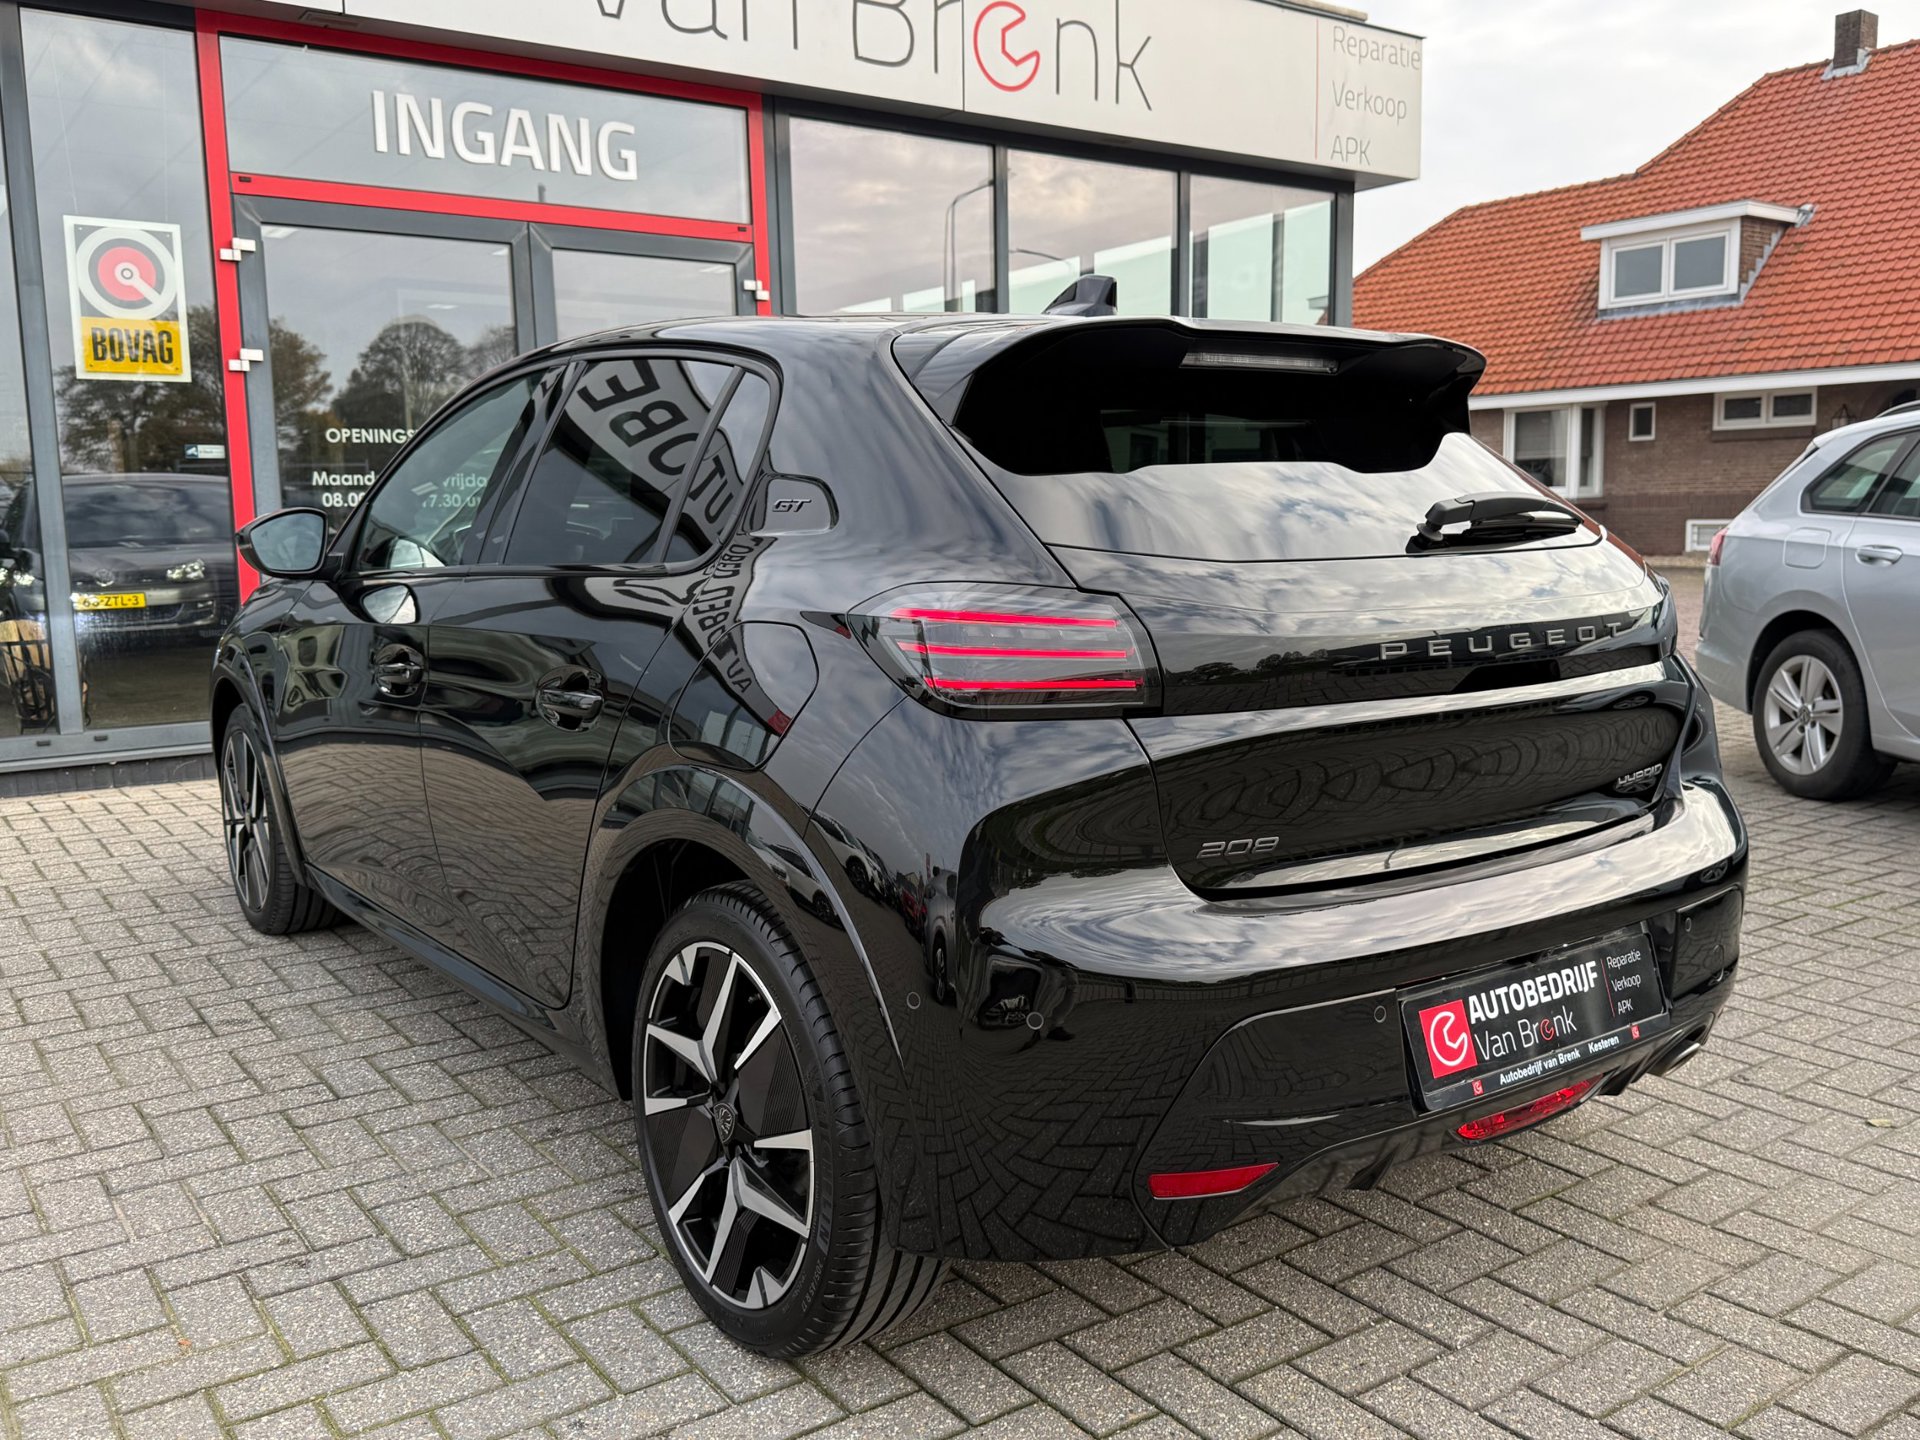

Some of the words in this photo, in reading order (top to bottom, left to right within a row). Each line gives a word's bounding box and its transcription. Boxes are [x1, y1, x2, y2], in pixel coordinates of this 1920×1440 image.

[1333, 25, 1421, 70] Reparatie
[1332, 80, 1407, 126] Verkoop
[372, 89, 638, 180] INGANG
[1330, 135, 1371, 166] APK
[91, 327, 174, 364] BOVAG
[325, 428, 419, 443] OPENINGS
[312, 471, 377, 486] Maand
[772, 499, 812, 513] GT
[1379, 622, 1622, 659] PEUGEOT
[1197, 836, 1279, 859] 208
[1607, 949, 1641, 969] Reparatie
[1468, 961, 1598, 1024] AUTOBEDRIJF
[1611, 973, 1641, 992] Verkoop
[1617, 998, 1634, 1015] APK
[1474, 1027, 1517, 1061] Van
[1500, 1062, 1544, 1085] Autobedrijf
[1543, 1057, 1558, 1069] van
[1558, 1048, 1581, 1065] Brenk
[1588, 1036, 1620, 1054] Kesteren
